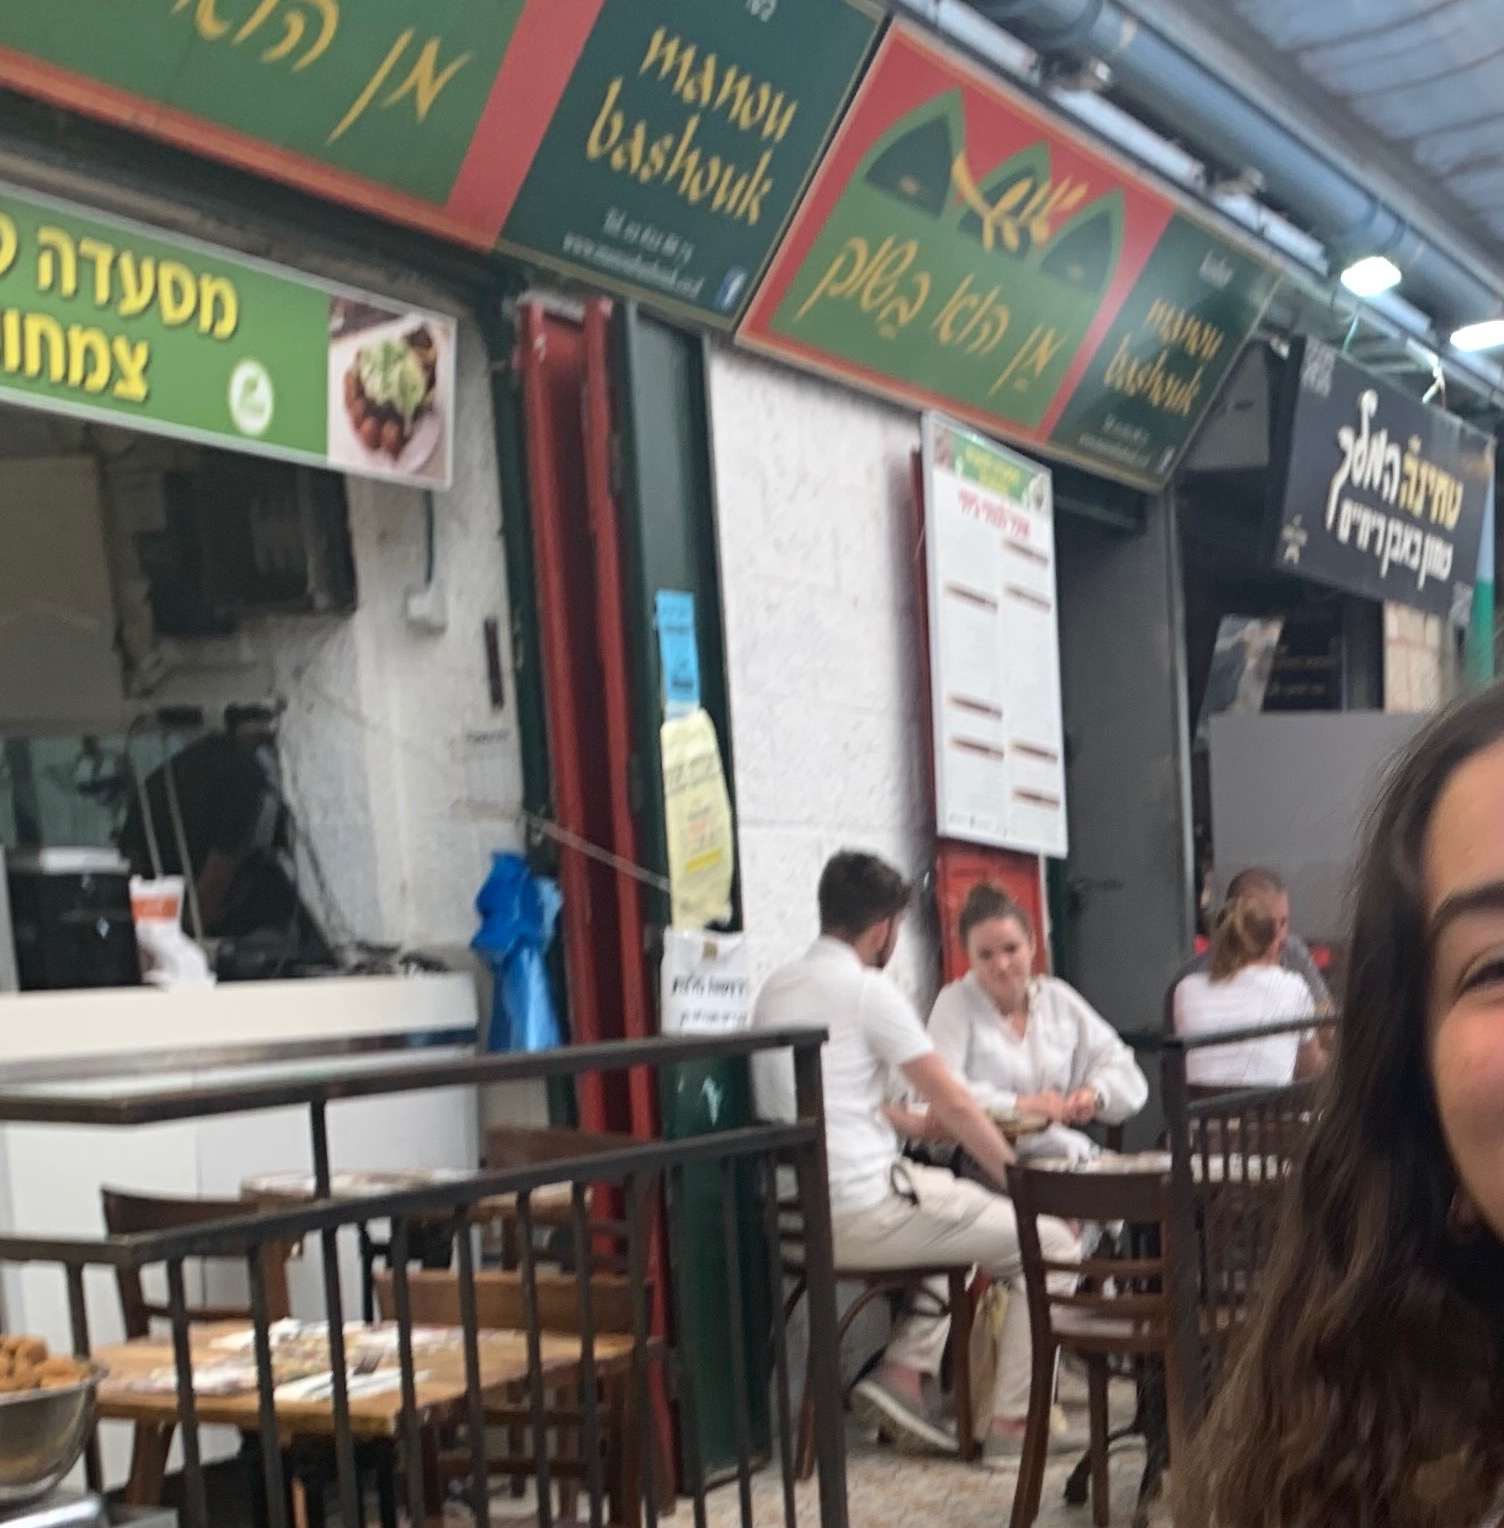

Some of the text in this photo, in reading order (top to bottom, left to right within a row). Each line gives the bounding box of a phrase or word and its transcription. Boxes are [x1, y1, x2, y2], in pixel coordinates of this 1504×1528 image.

[638, 26, 798, 144] manou
[586, 76, 775, 227] bashouk
[37, 225, 239, 340] מסעדה
